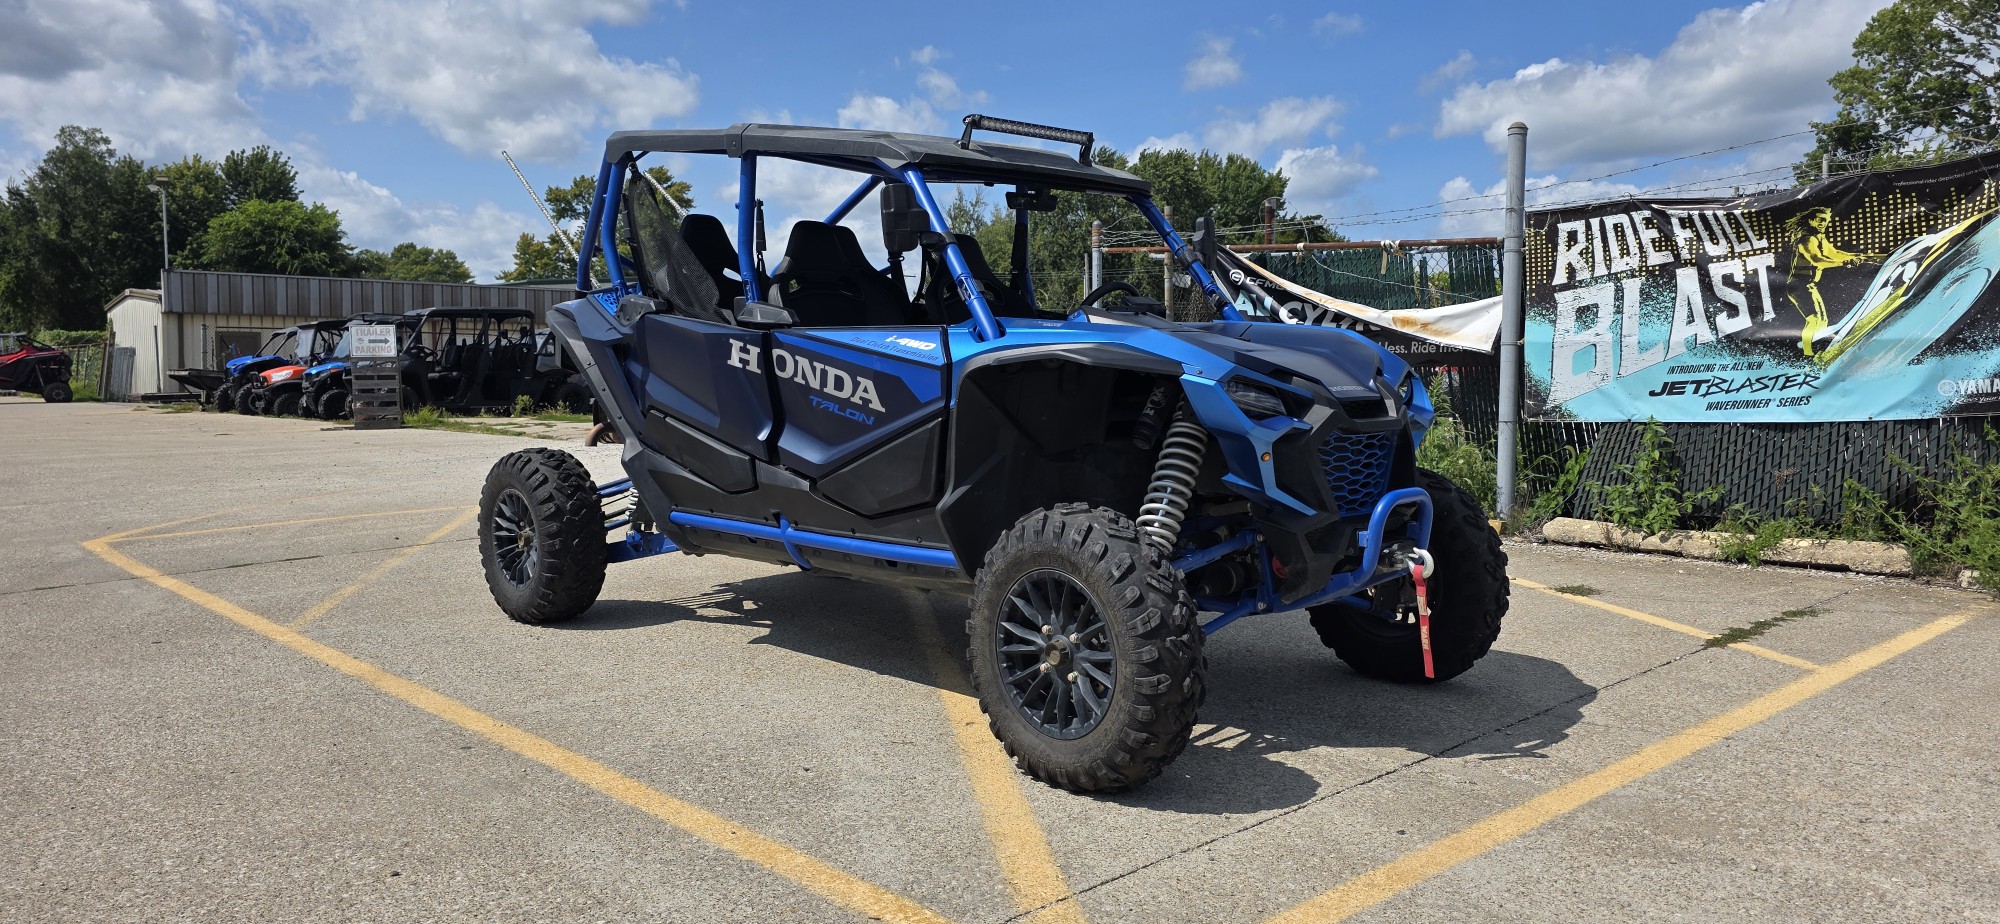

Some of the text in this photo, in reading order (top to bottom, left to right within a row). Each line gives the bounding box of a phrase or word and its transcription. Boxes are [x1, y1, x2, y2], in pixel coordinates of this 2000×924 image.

[1551, 209, 1769, 286] RIDE FULL
[355, 327, 391, 337] TRAILER
[1547, 253, 1776, 407] BLAST
[355, 346, 392, 355] PARKING
[1411, 341, 1437, 354] Ride
[727, 338, 886, 413] HONDA
[1667, 361, 1764, 375] INTRODUCING THE ALL-NEW
[809, 395, 875, 425] TALON
[1776, 396, 1812, 408] SERIES
[1420, 625, 1430, 651] WARN
